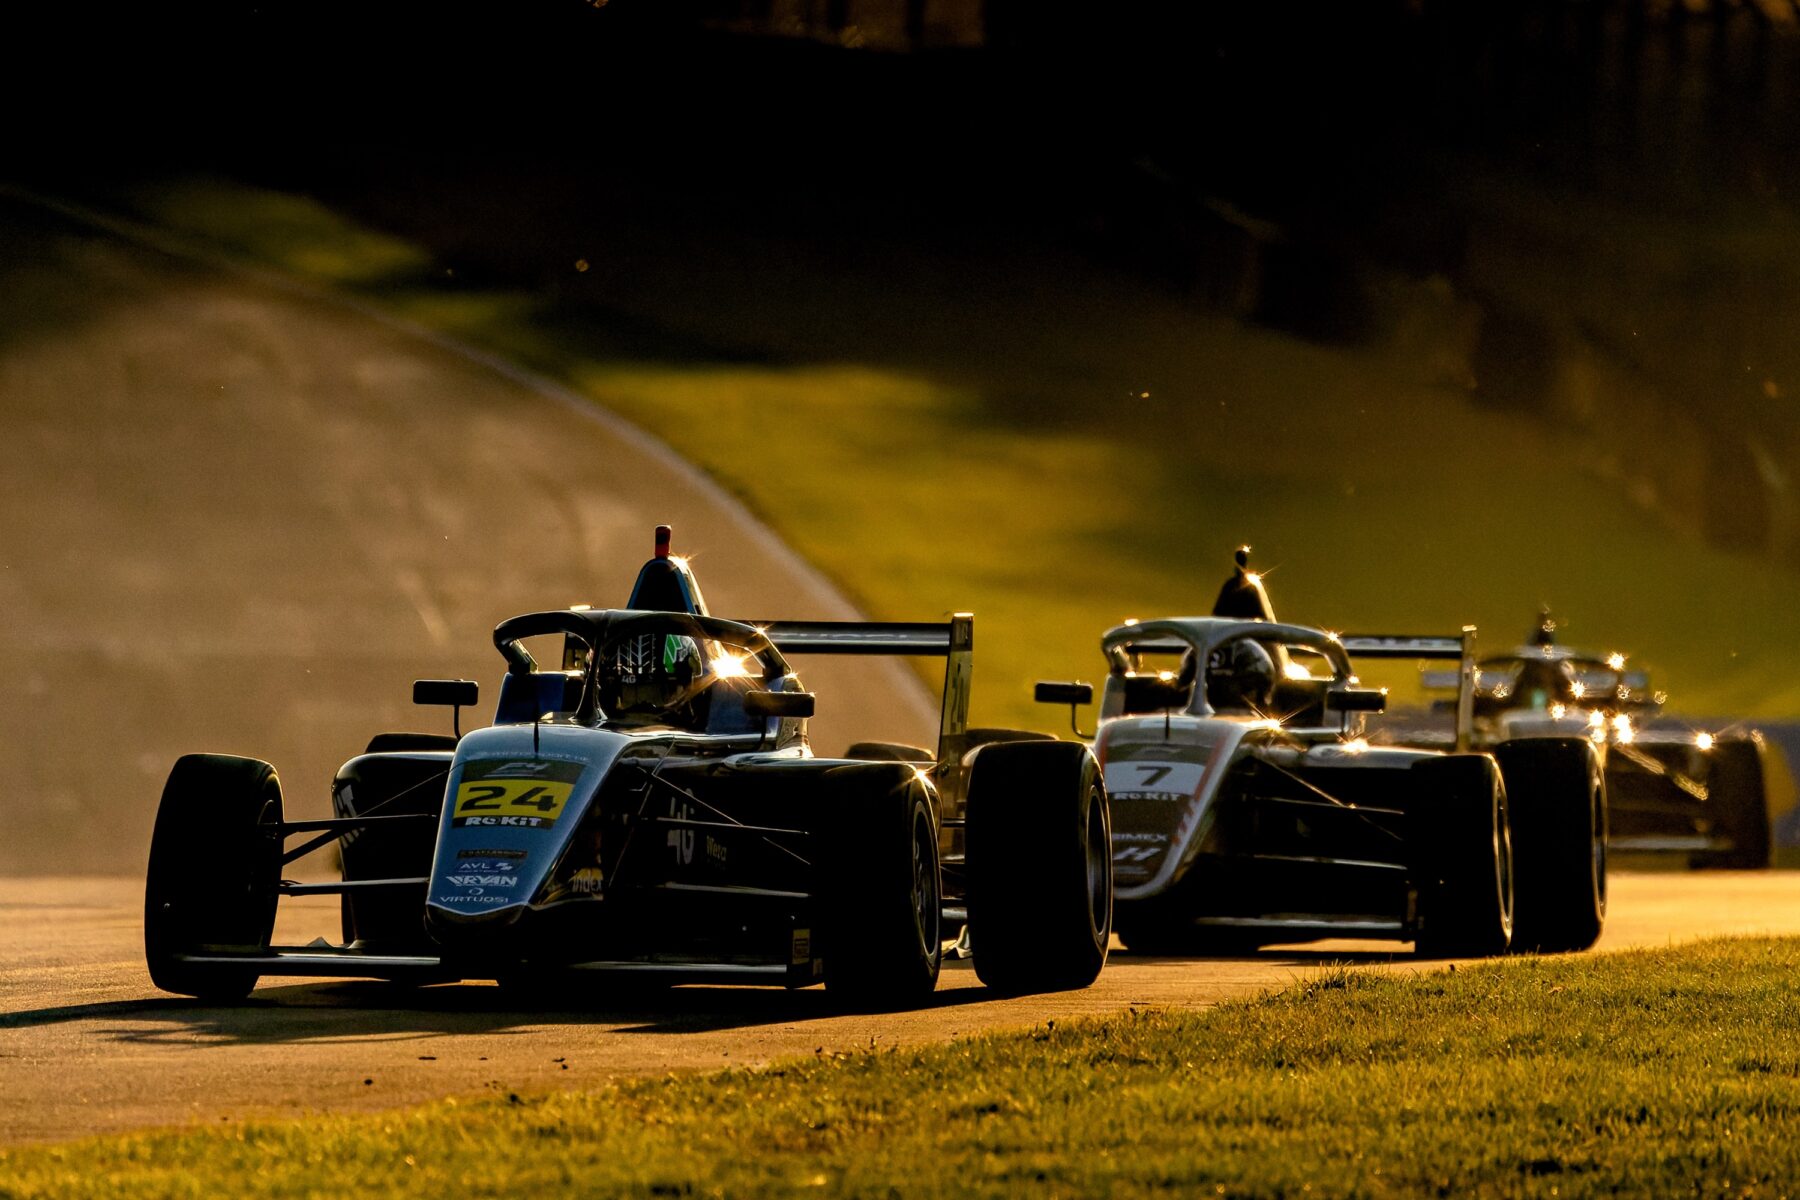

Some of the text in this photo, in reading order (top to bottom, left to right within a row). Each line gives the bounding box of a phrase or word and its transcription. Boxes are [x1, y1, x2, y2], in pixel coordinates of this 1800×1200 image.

[1136, 766, 1173, 786] 7
[460, 785, 558, 811] 24
[463, 875, 518, 887] RYAN
